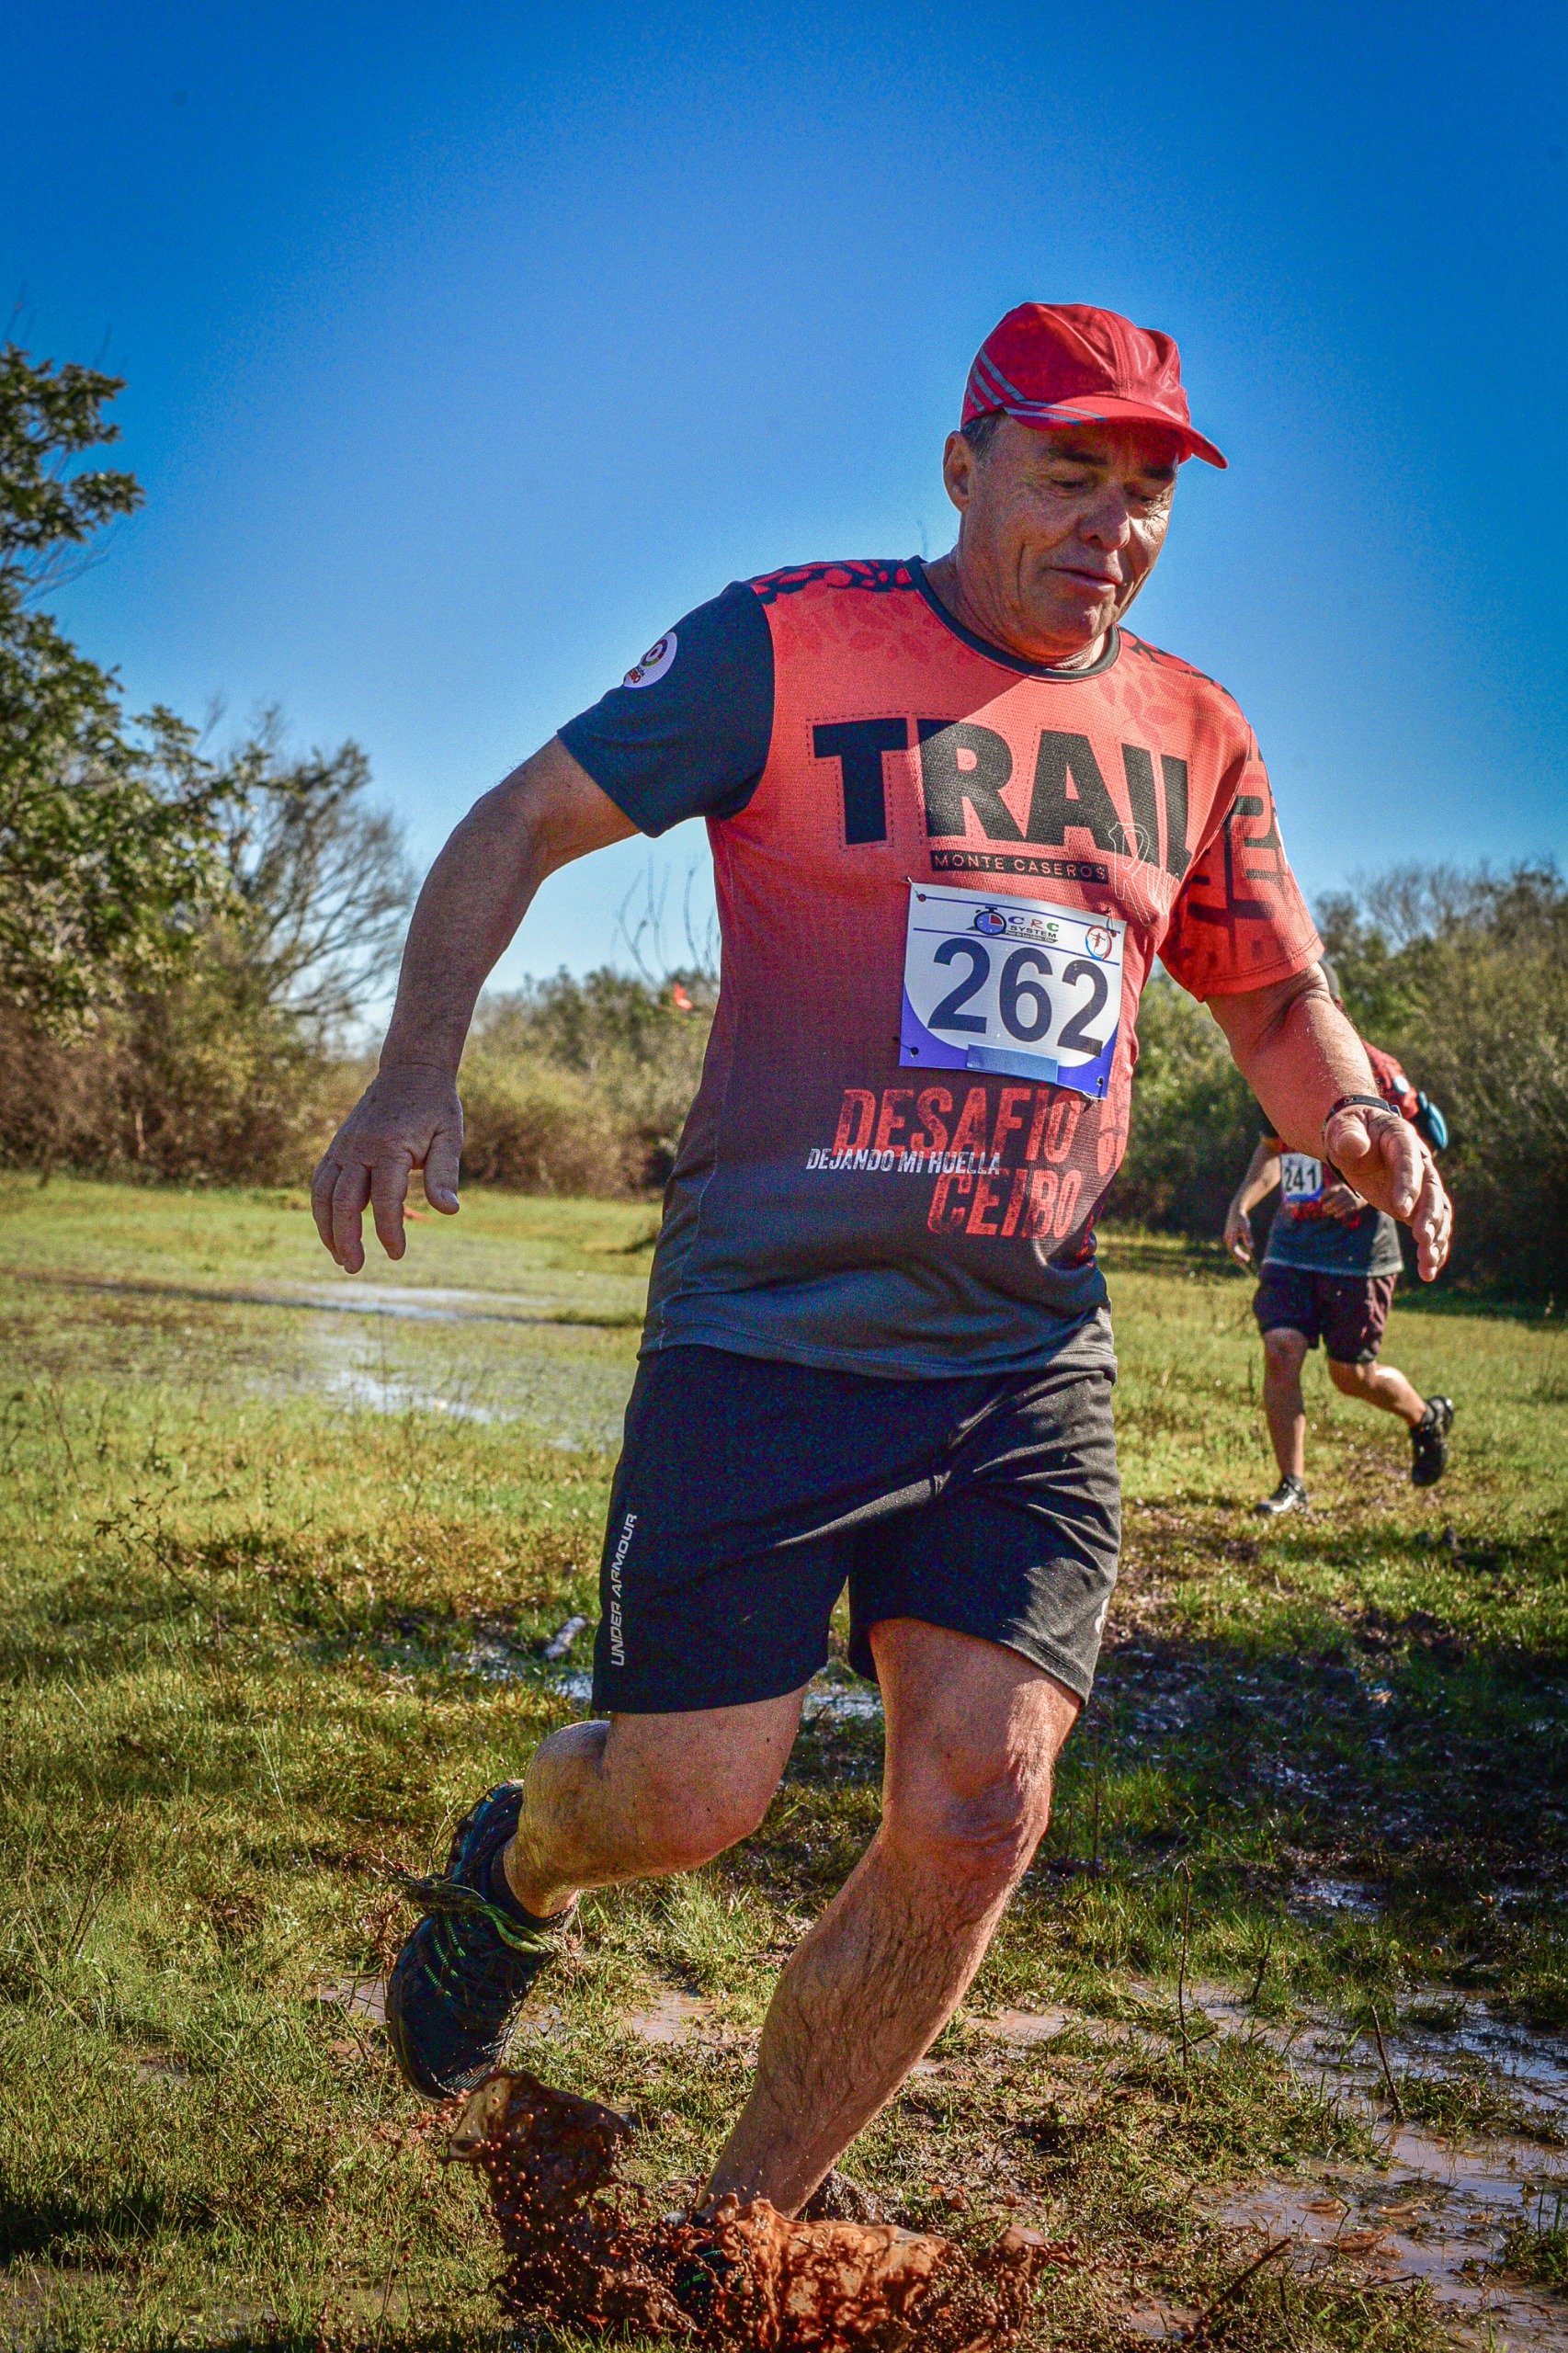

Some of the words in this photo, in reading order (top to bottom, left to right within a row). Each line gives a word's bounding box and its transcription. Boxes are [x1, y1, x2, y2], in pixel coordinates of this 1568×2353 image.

[935, 854, 1005, 870] MONTE
[1014, 858, 1106, 881] CASEROS
[1008, 916, 1059, 932] CRC
[1010, 926, 1057, 938] SYSTEM
[927, 938, 1108, 1058] 262
[832, 1087, 1081, 1164] DESAFIO
[806, 1148, 894, 1171] DEJANDO
[897, 1151, 925, 1173] MI
[927, 1151, 1001, 1176] HUELLA
[1284, 1165, 1317, 1192] 241
[927, 1169, 1082, 1239] CEIBO
[610, 1513, 638, 1598] ARMOUR
[611, 1600, 625, 1666] UNDER
